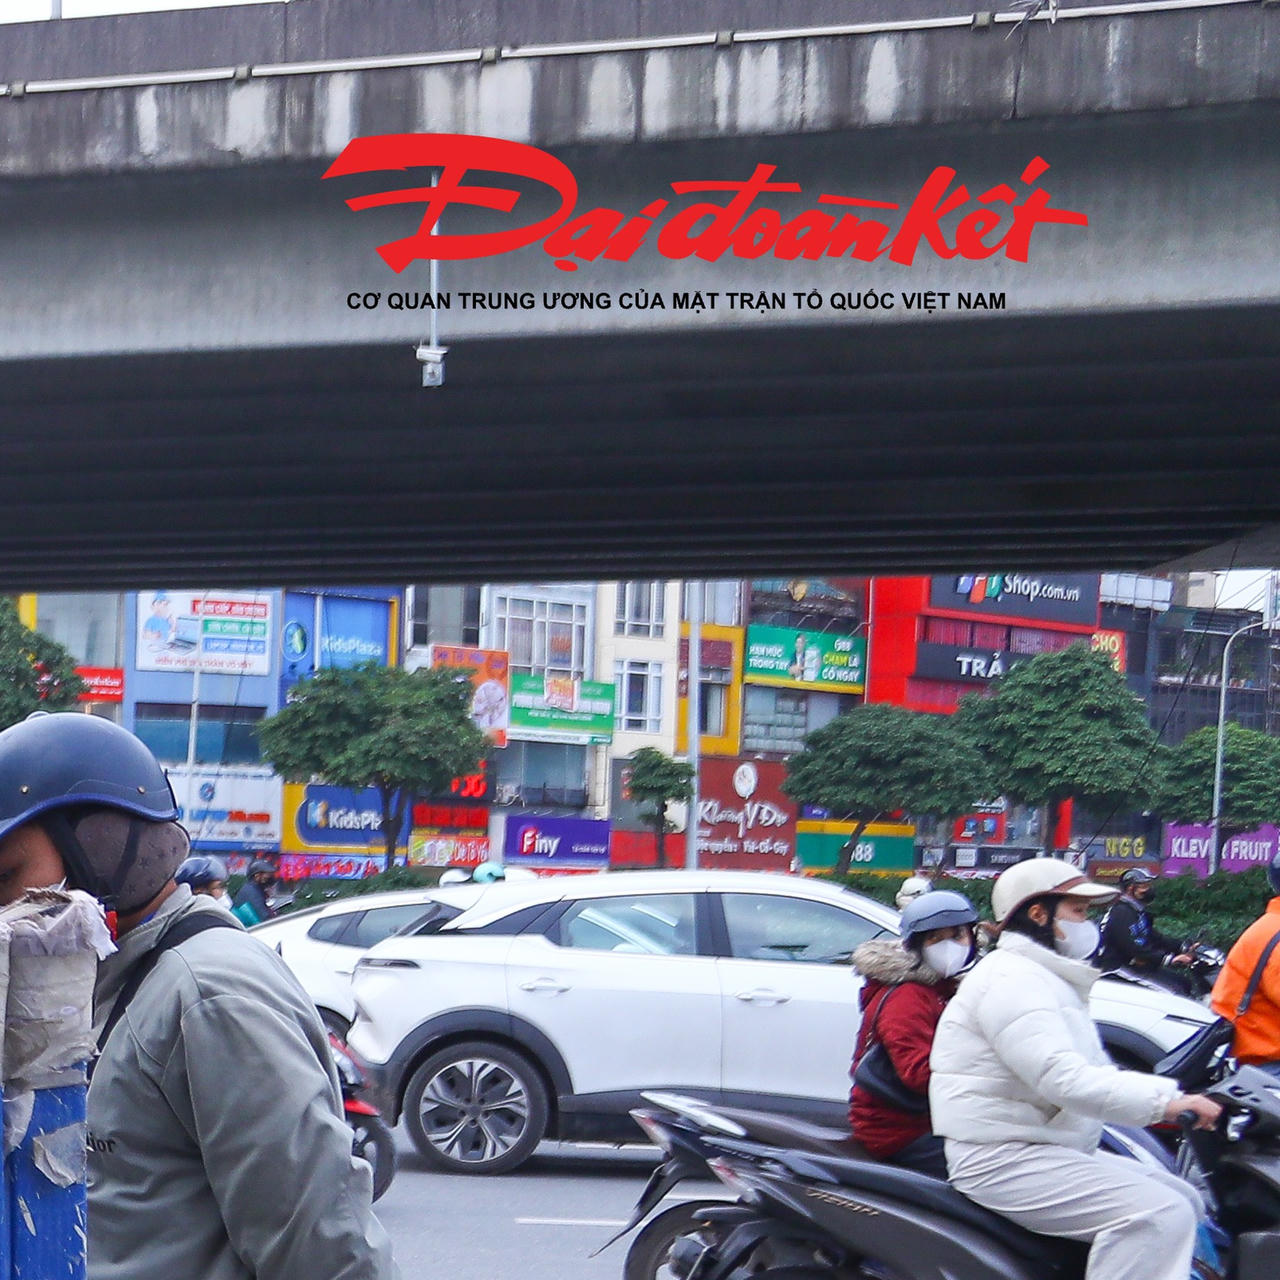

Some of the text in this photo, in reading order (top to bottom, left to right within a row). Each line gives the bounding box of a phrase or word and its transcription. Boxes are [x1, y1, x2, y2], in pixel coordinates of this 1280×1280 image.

[849, 842, 876, 863] 88
[1230, 838, 1273, 862] FRUIT
[86, 1131, 117, 1153] ior
